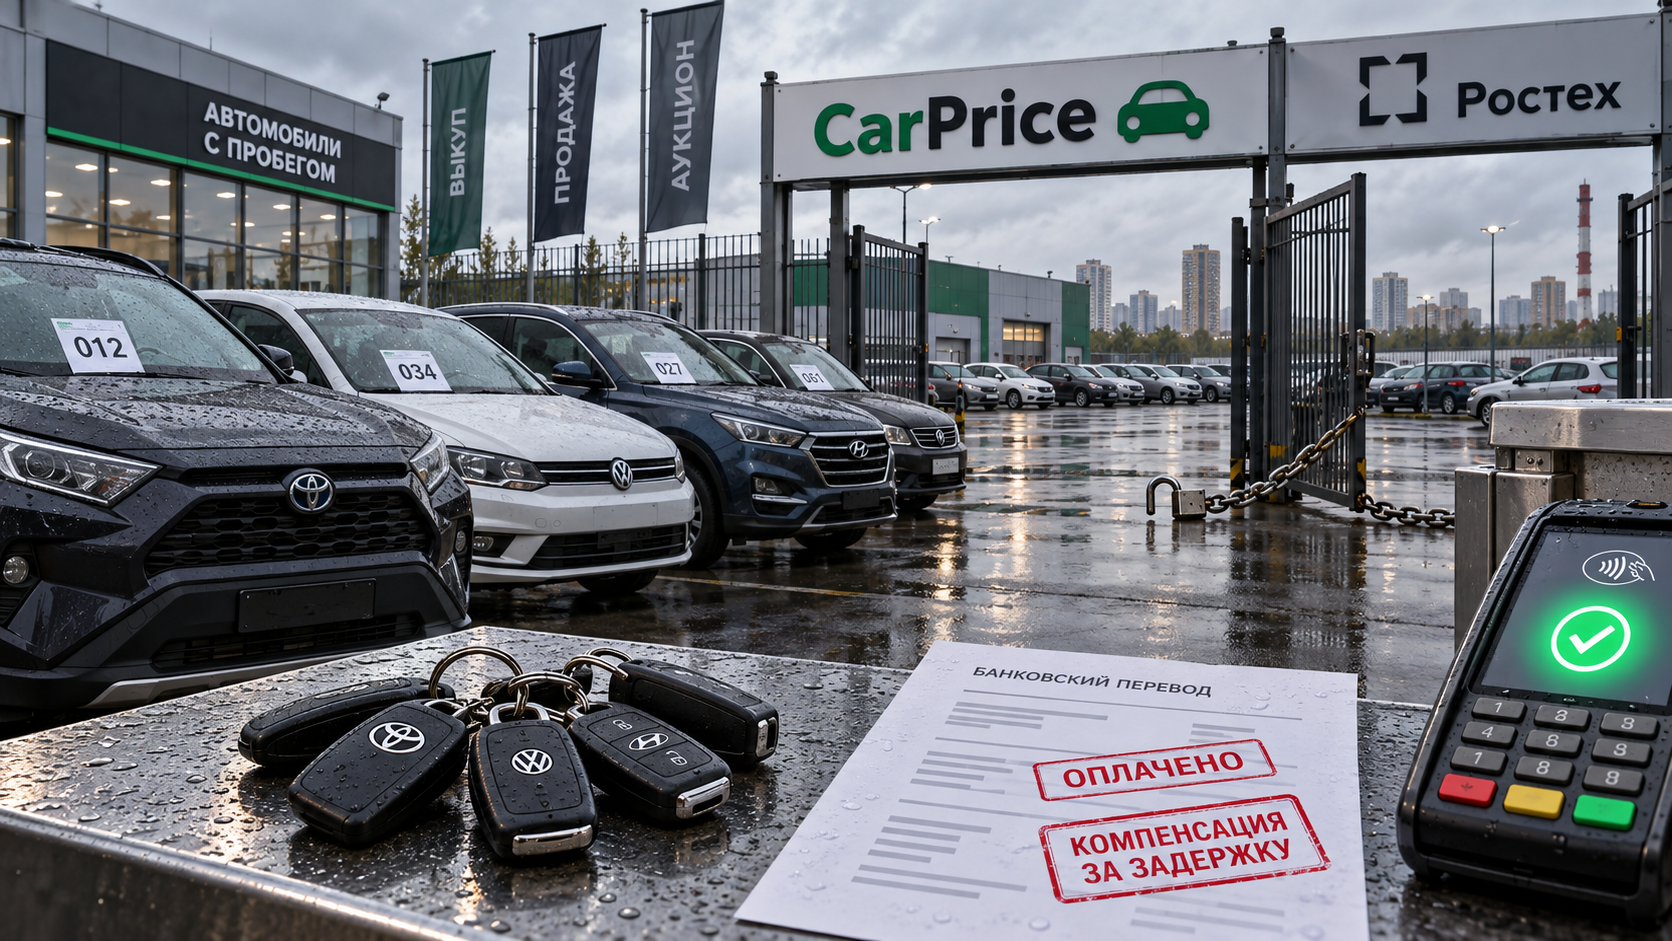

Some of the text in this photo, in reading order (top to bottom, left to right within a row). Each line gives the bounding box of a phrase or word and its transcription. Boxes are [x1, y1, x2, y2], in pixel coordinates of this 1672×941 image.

[671, 39, 696, 192] АУКЦИОН
[1458, 81, 1622, 118] Ростех
[204, 101, 342, 159] АВТОМОБИЛИ
[554, 61, 576, 204] ПРОДАЖА
[814, 88, 1097, 157] CarPrice
[204, 131, 336, 184] С ПРОБЕГОМ
[450, 107, 466, 197] ВЫКУП
[73, 336, 128, 358] 012
[398, 363, 437, 380] 034
[655, 362, 682, 375] 027
[973, 666, 1212, 698] БАНКОВСКИЙ ПЕРЕВОД
[1494, 702, 1503, 713] 1
[1481, 726, 1494, 738] 4
[1063, 751, 1244, 788] ОПЛАЧЕНО
[1536, 760, 1550, 775] 8
[1070, 811, 1288, 857] КОМПЕНСАЦИЯ
[1082, 838, 1290, 884] ЗА ЗАДЕРЖКУ
